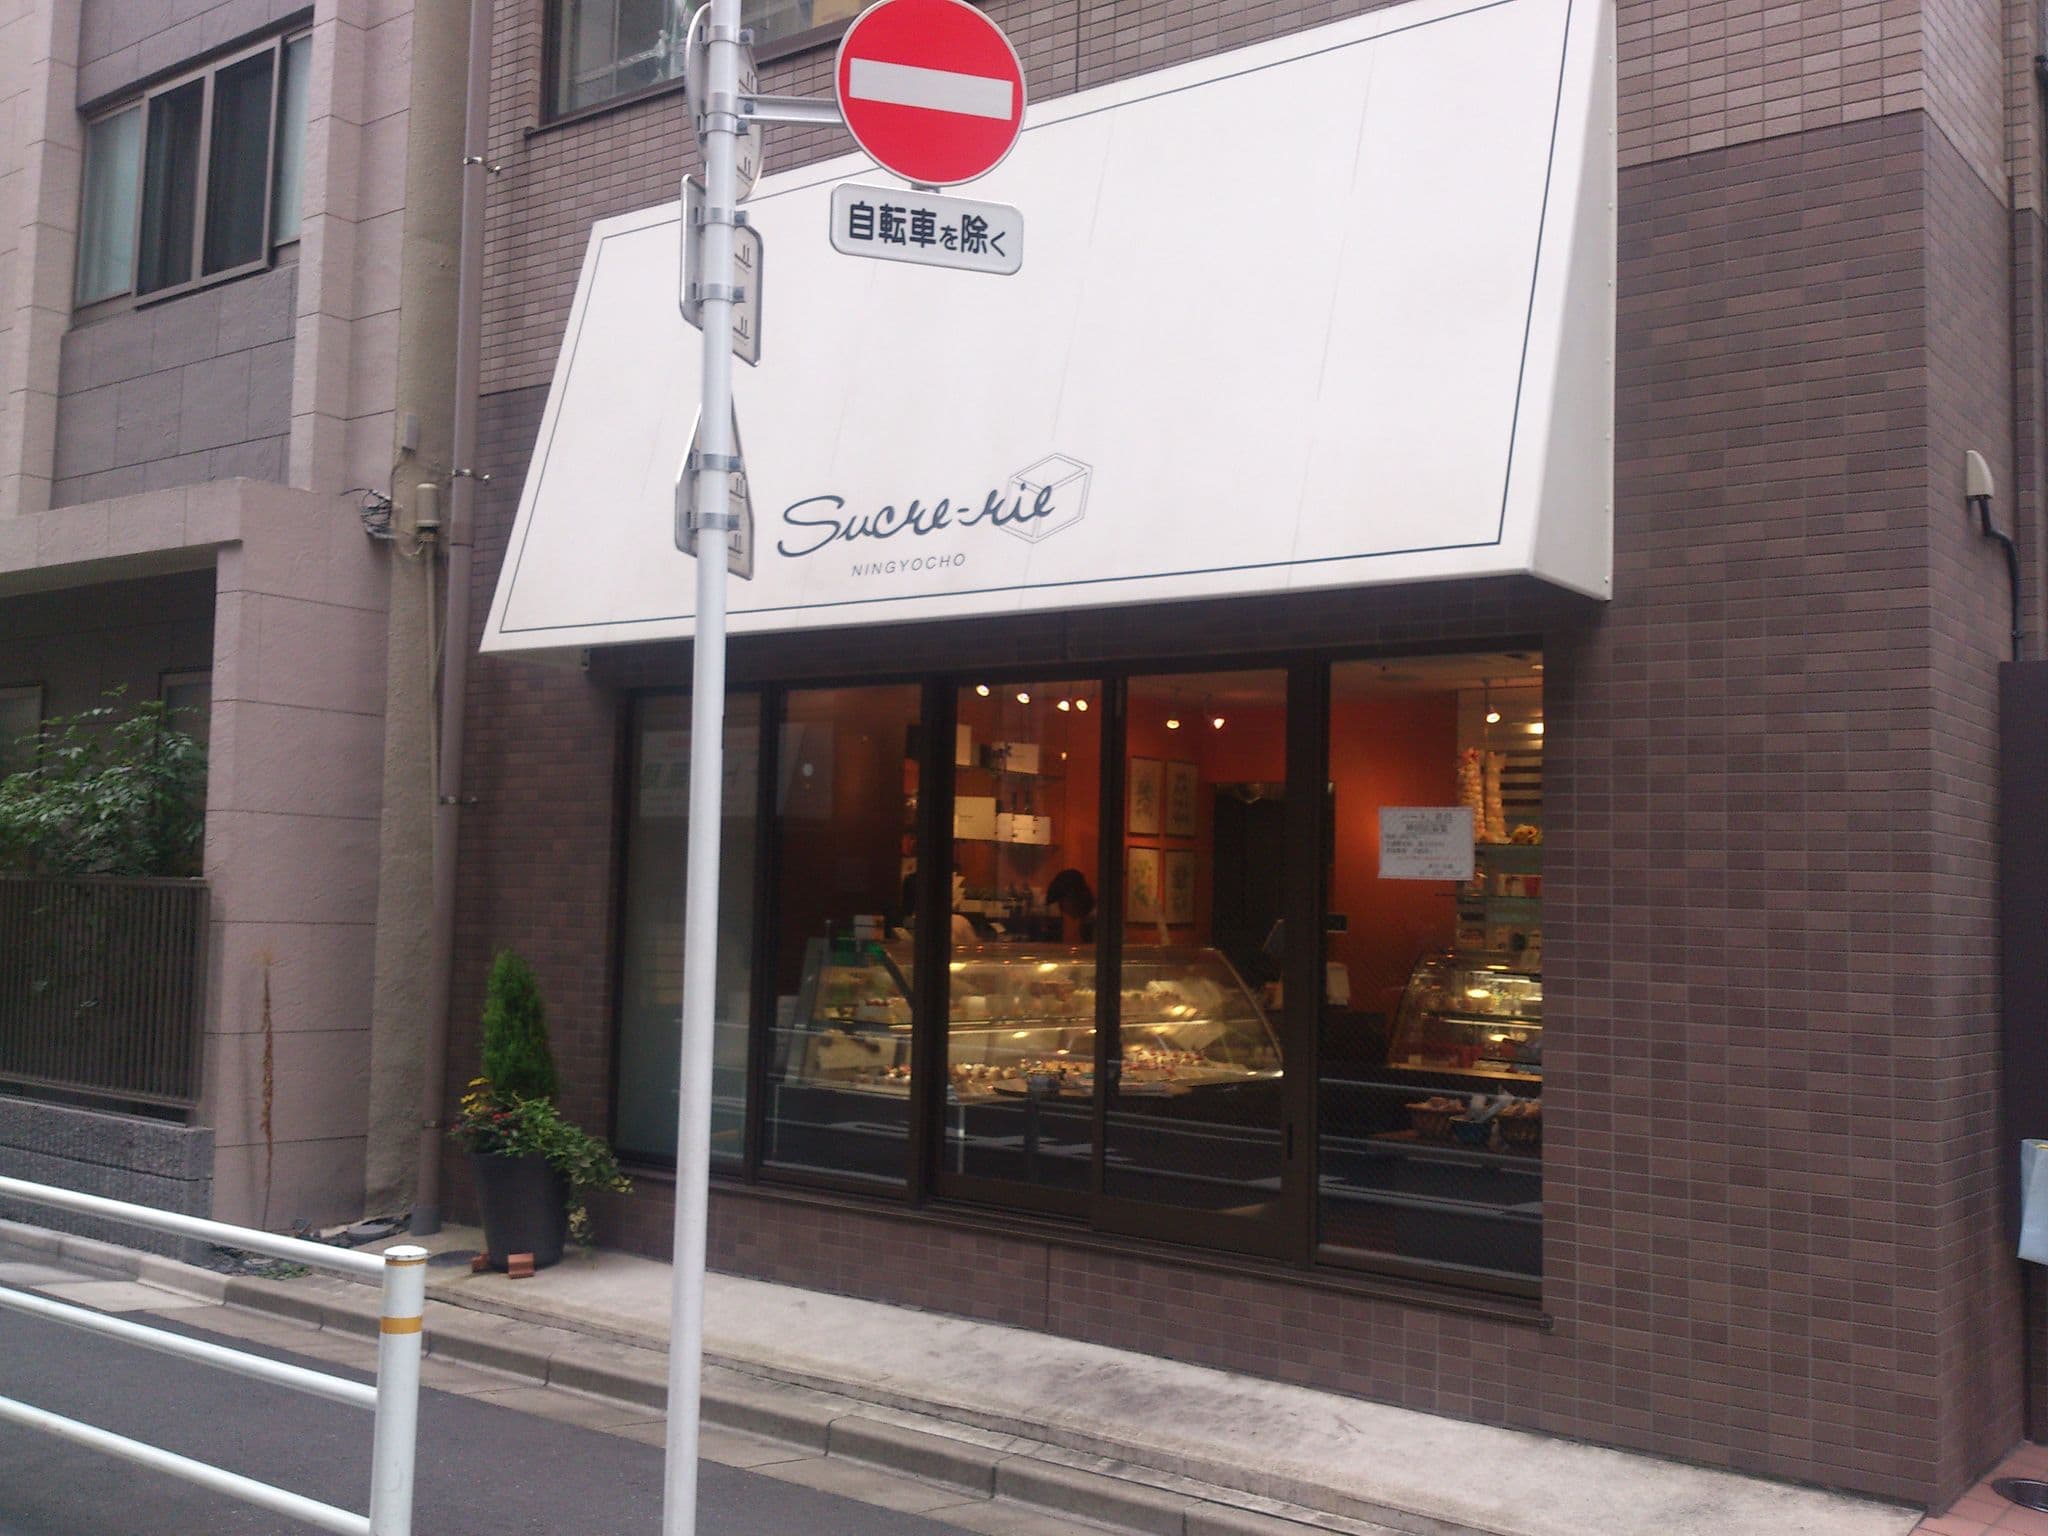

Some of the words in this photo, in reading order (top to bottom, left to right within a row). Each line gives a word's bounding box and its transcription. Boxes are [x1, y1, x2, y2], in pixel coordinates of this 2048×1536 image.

[850, 201, 1006, 257] 自転車を除く
[777, 482, 1055, 557] Sucre-rie
[851, 553, 966, 577] NINGYOCHO
